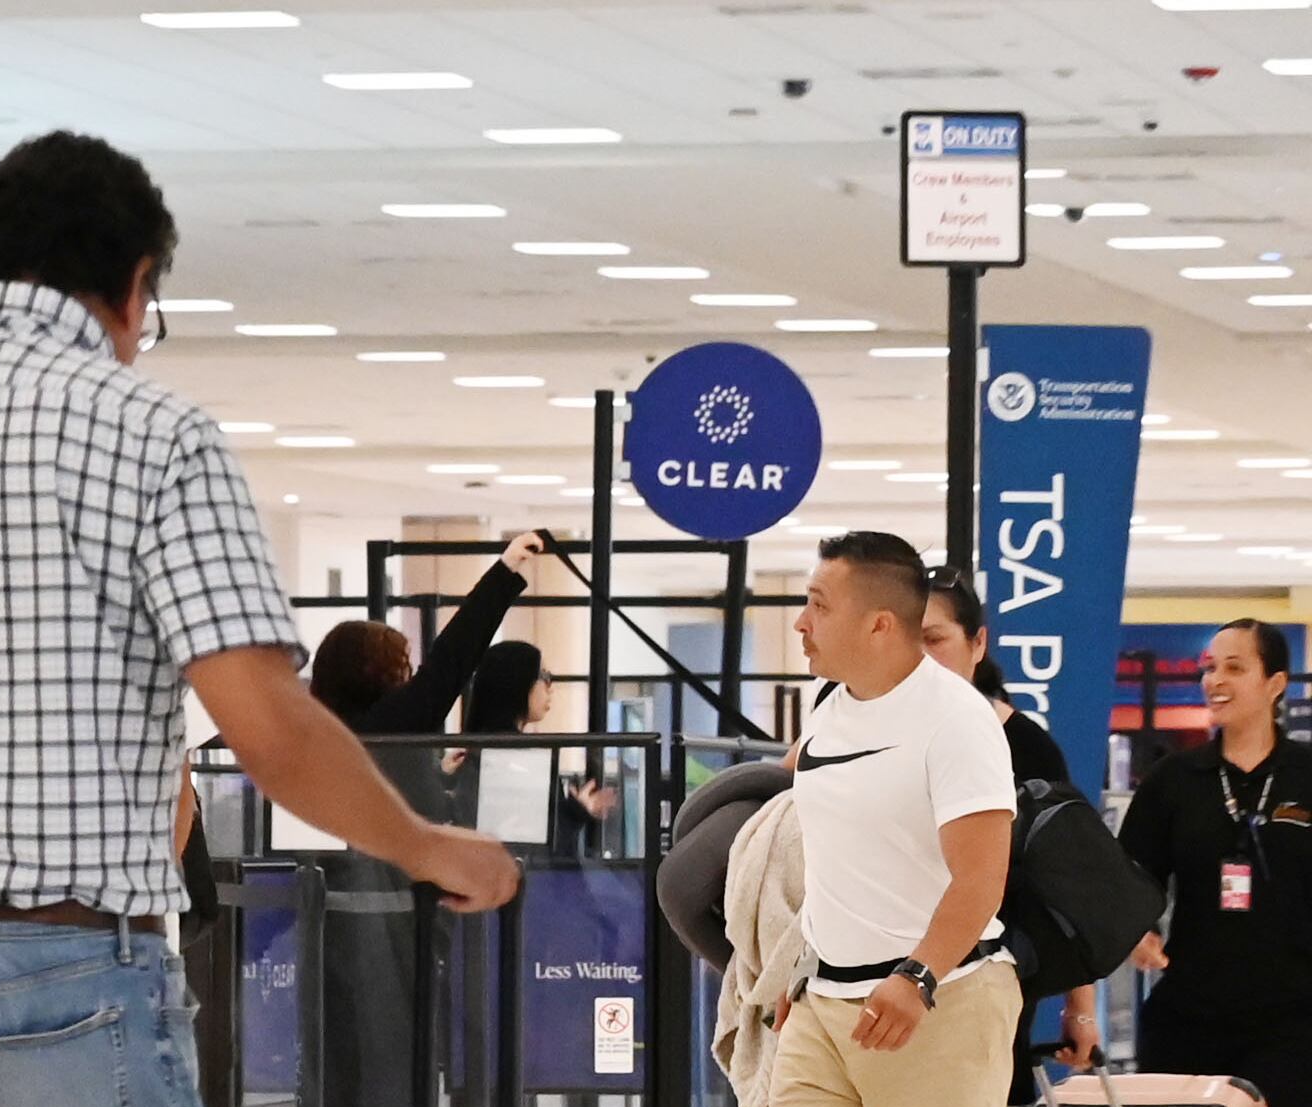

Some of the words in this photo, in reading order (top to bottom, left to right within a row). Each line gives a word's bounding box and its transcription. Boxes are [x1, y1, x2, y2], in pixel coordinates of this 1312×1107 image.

[943, 125, 968, 146] ON
[971, 125, 1019, 146] DUTY
[913, 172, 947, 186] Crew
[952, 172, 1013, 186] Members
[940, 211, 987, 226] Airport
[926, 232, 1001, 249] Employees
[1038, 378, 1134, 395] Transportation
[1038, 394, 1093, 411] Security
[1038, 407, 1136, 421] Administration
[657, 459, 784, 491] CLEAR
[998, 472, 1065, 614] TSA
[535, 962, 572, 979] Less
